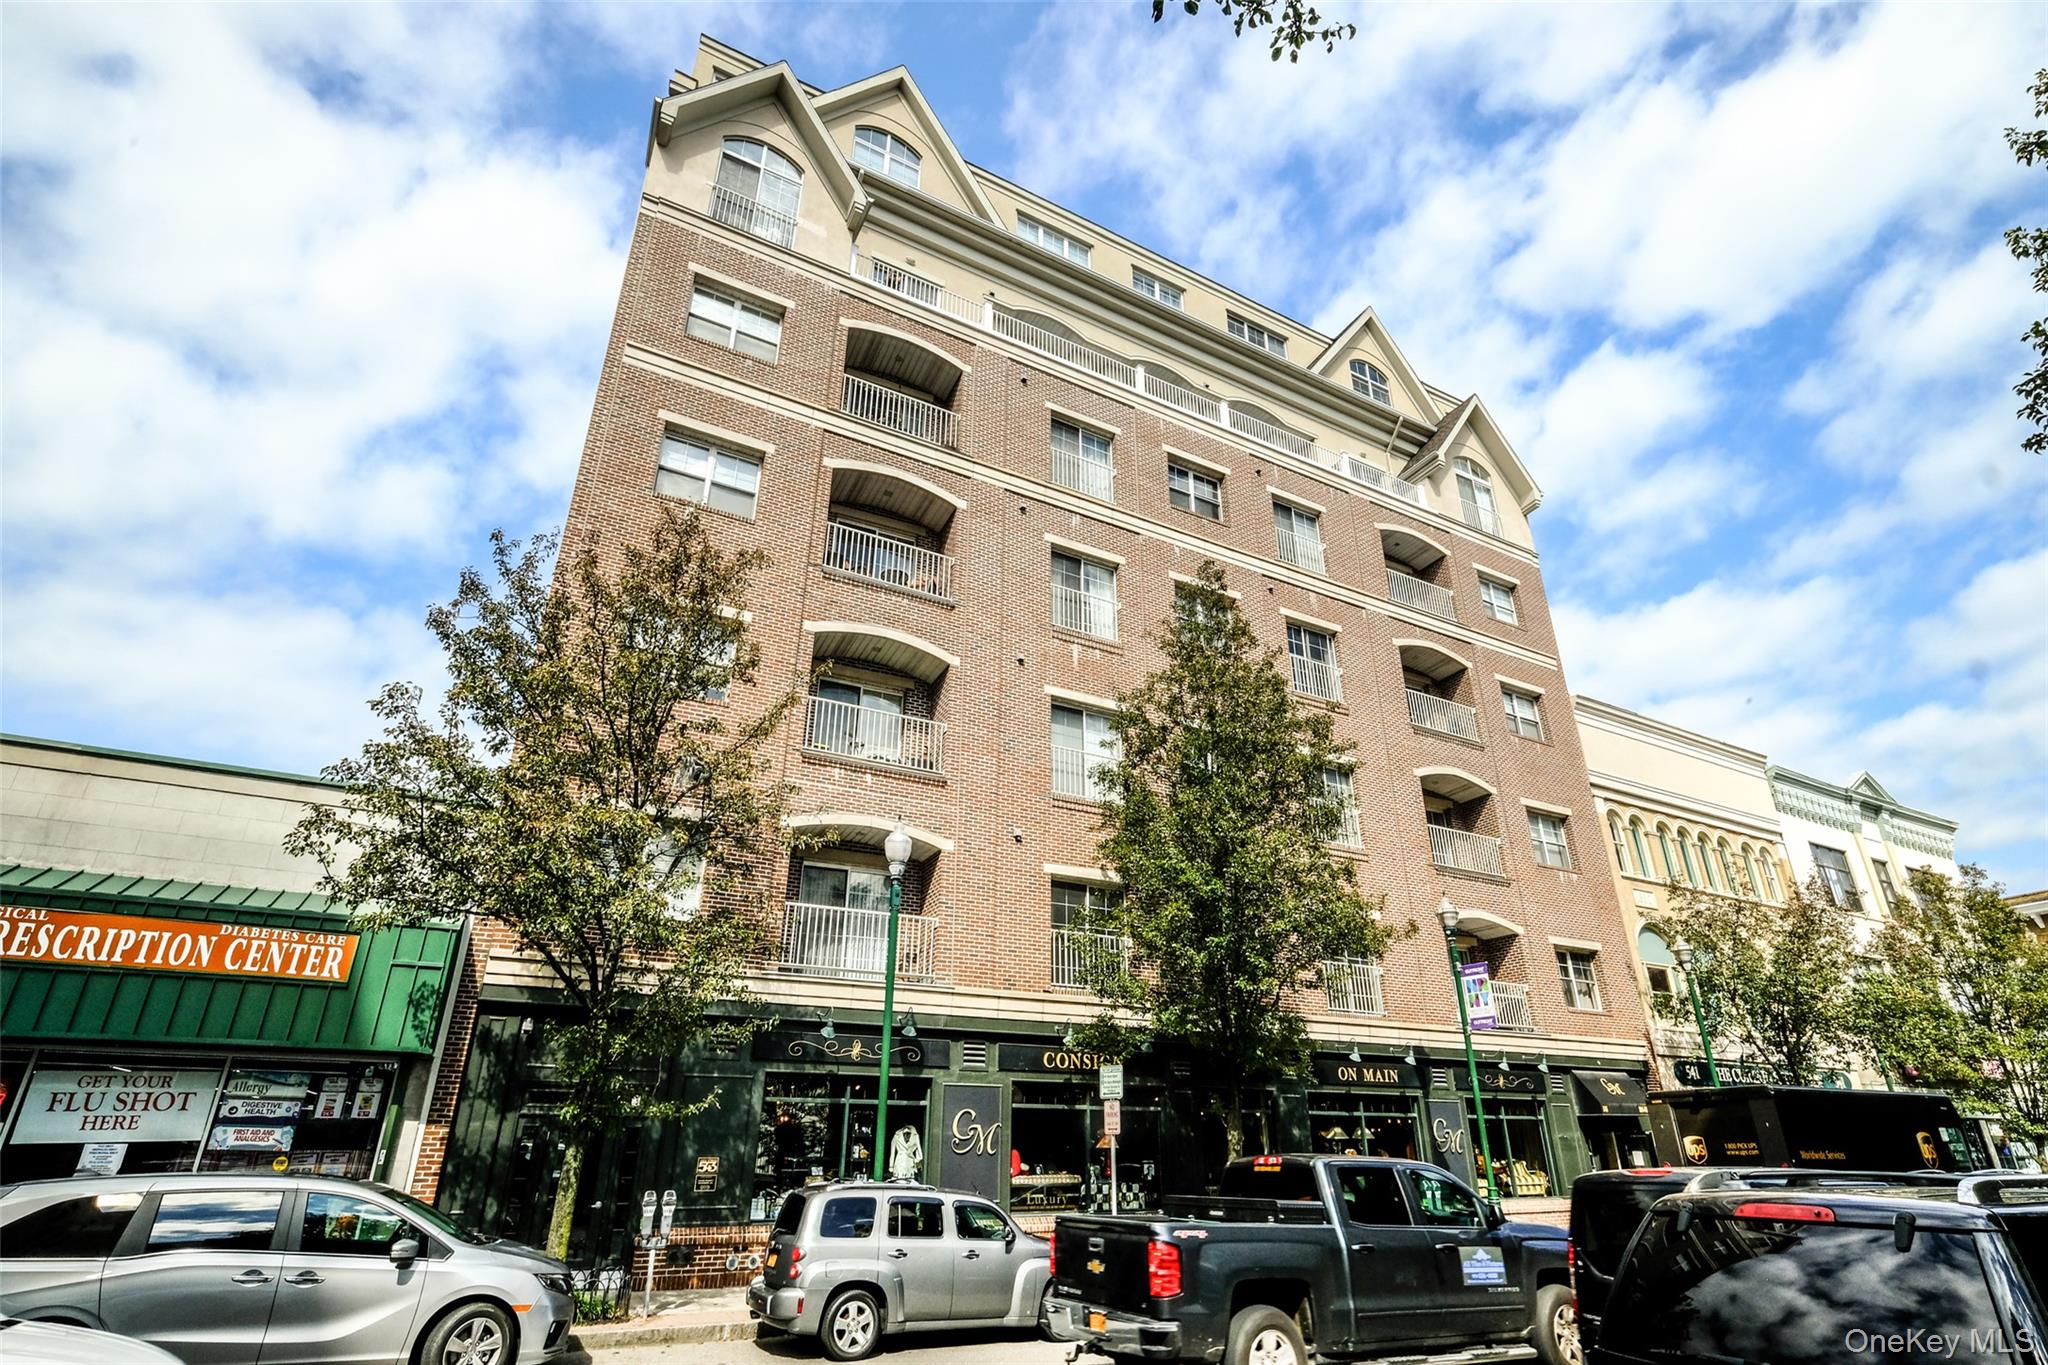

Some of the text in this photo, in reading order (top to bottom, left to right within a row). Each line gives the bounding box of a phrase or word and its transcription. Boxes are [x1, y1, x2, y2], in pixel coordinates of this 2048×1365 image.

[220, 925, 347, 947] DIABETES CARE
[224, 938, 343, 979] CENTER
[77, 1074, 173, 1089] GET YOUR
[1338, 1066, 1399, 1082] ON MAIN
[1714, 1067, 1733, 1082] HE
[230, 1081, 272, 1095] Allergy
[46, 1091, 197, 1112] FLU SHOT
[241, 1101, 284, 1109] DIGESTIVE
[79, 1115, 141, 1131] HERE
[1687, 1143, 1705, 1159] ups
[1026, 1193, 1068, 1206] Luxury
